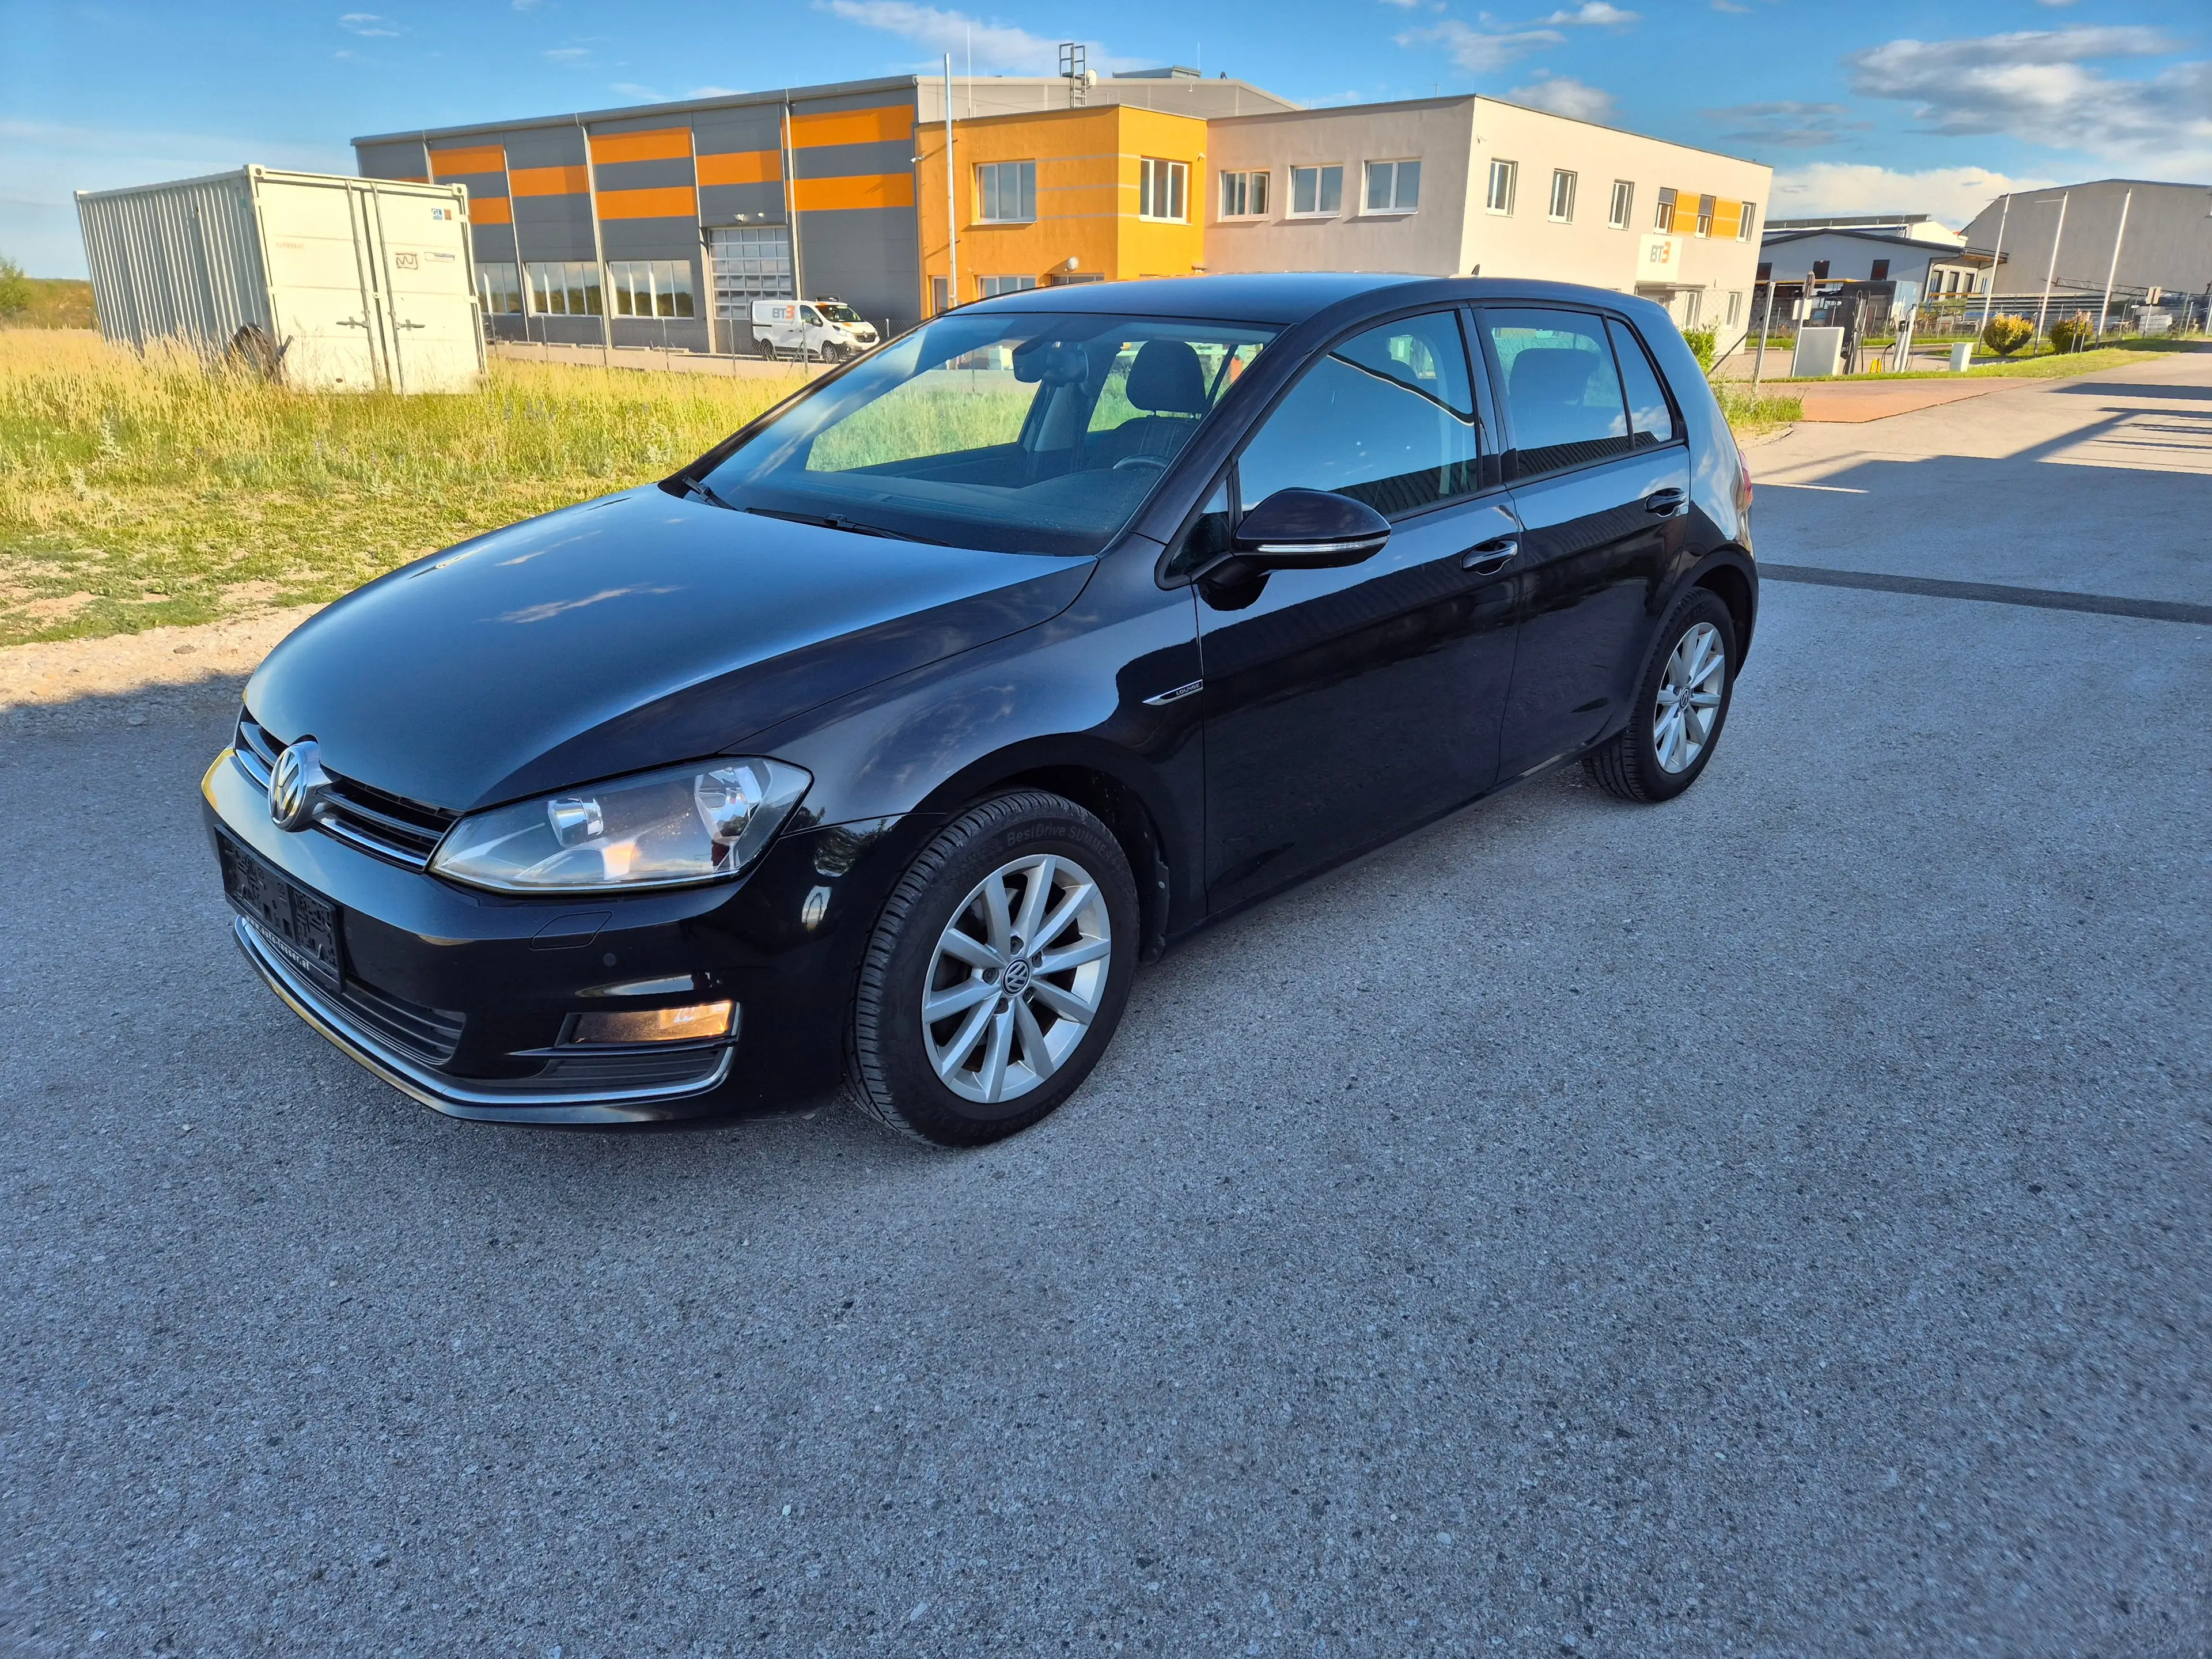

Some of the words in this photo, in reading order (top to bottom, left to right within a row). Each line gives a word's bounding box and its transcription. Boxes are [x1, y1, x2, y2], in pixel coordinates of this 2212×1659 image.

[1650, 241, 1671, 263] BT3
[772, 305, 795, 319] BT3
[1176, 683, 1200, 695] LOUNGE
[1007, 823, 1066, 847] BestDrive
